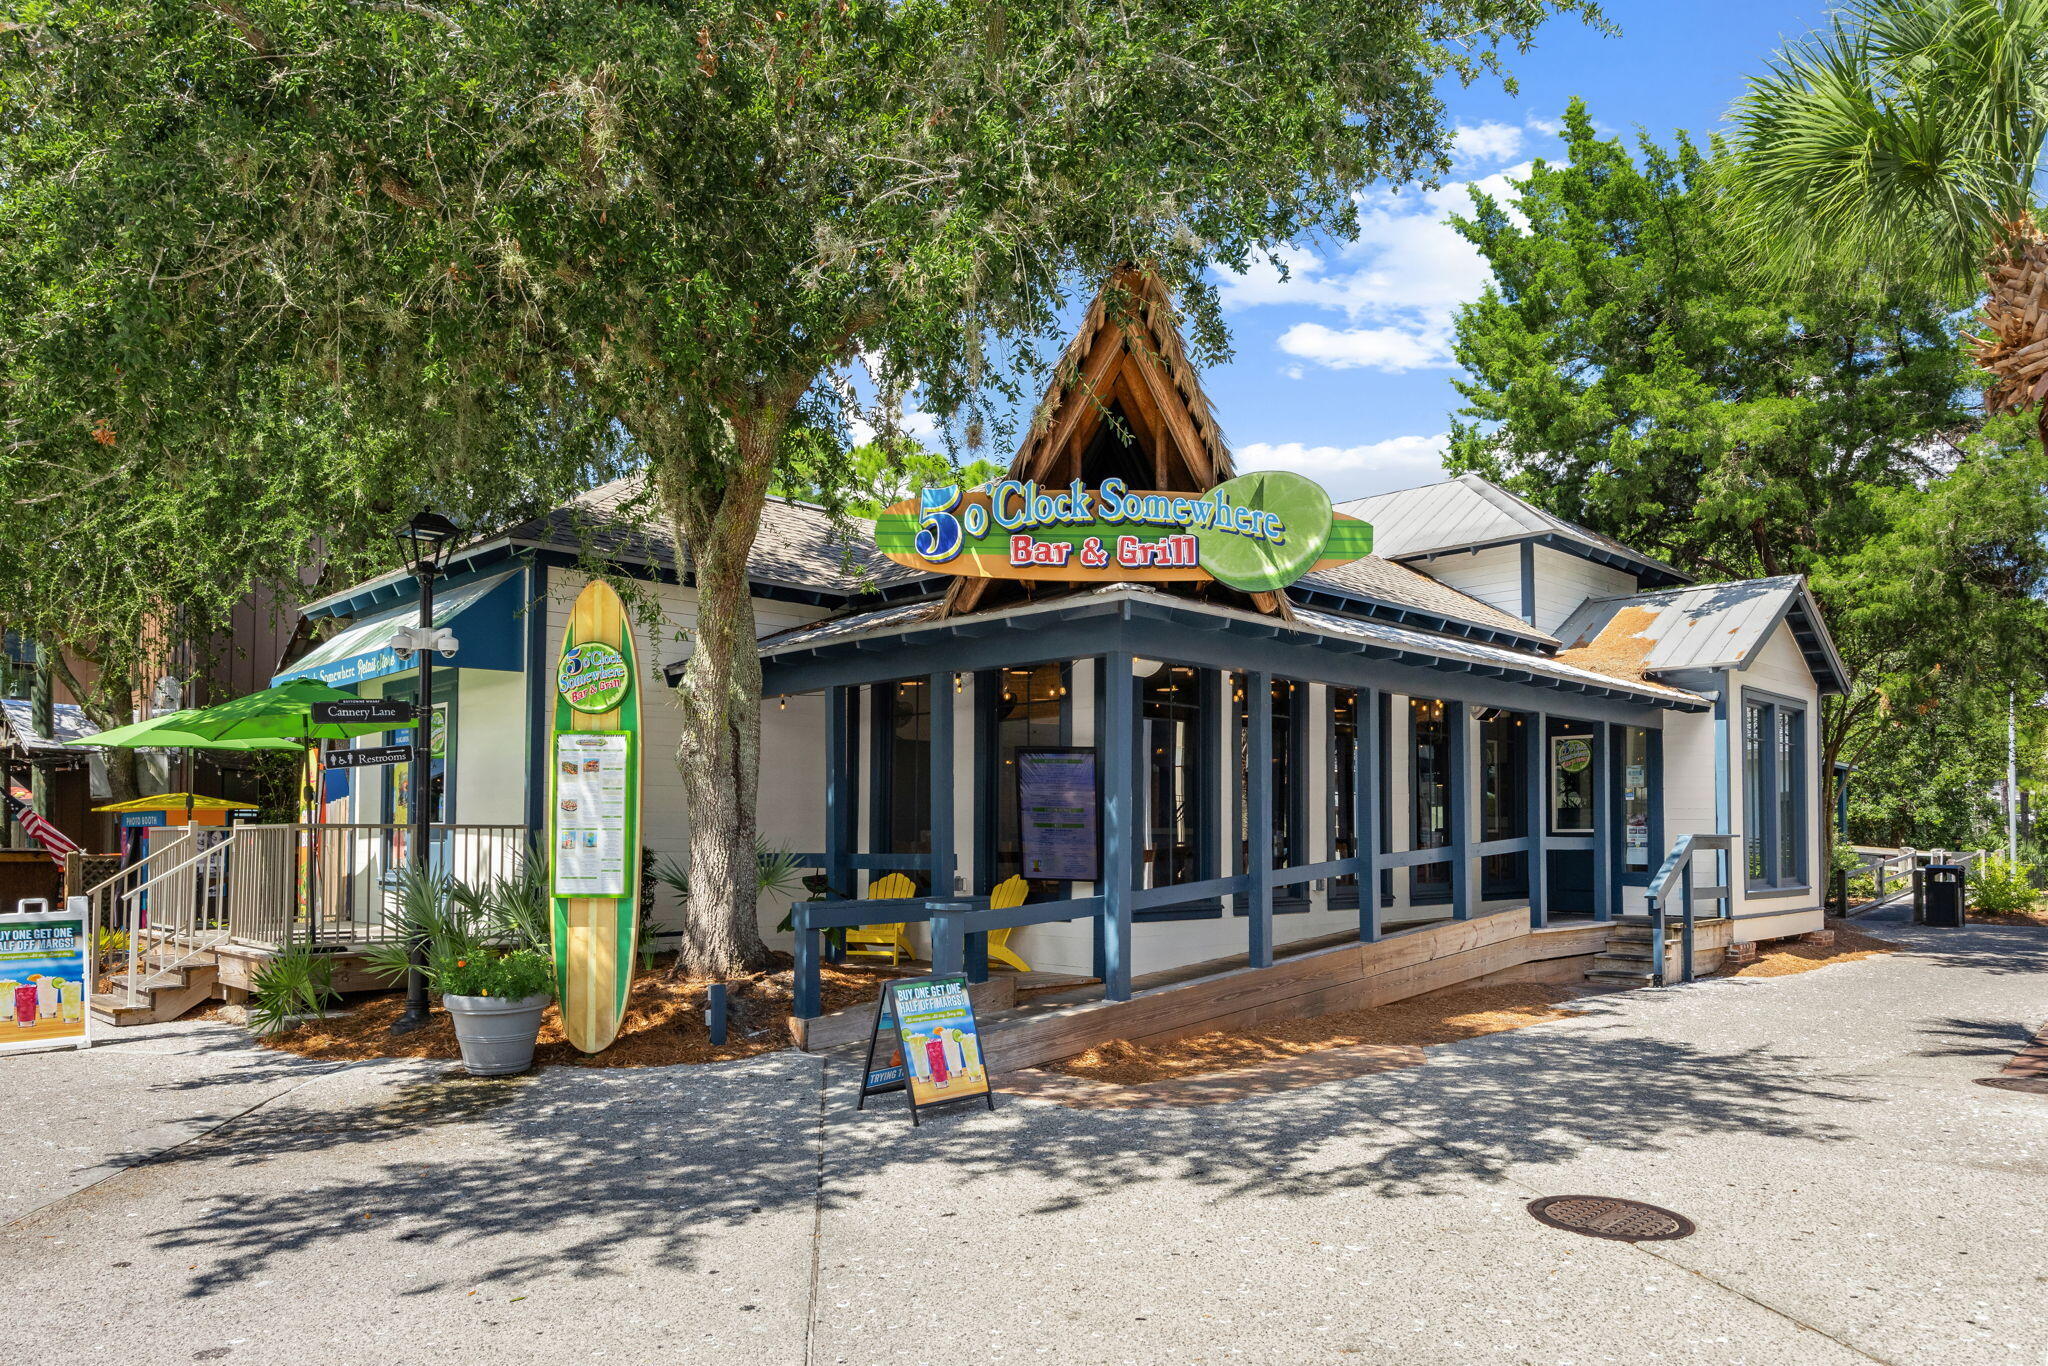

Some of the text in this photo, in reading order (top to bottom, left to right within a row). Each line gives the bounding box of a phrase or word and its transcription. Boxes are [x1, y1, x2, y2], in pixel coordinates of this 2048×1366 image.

[915, 484, 964, 563] 5
[1098, 477, 1286, 546] Somewhere
[1010, 534, 1199, 569] Bar & Grill
[320, 664, 355, 682] Somewhere
[357, 657, 376, 679] Retail
[565, 648, 582, 675] 5
[560, 666, 625, 693] Somewhere
[571, 679, 621, 703] Bar & Grill
[327, 705, 396, 720] Cannery Lane
[358, 753, 407, 765] Restrooms
[126, 815, 157, 826] PHOTO BOOTH
[0, 927, 73, 942] UY ONE GET ONE
[0, 937, 74, 951] ALF OFF MARGS!
[897, 982, 962, 1002] BUY ONE GET ONE
[898, 994, 965, 1014] HALF OFF MARGS!
[870, 1069, 897, 1084] TRYING
